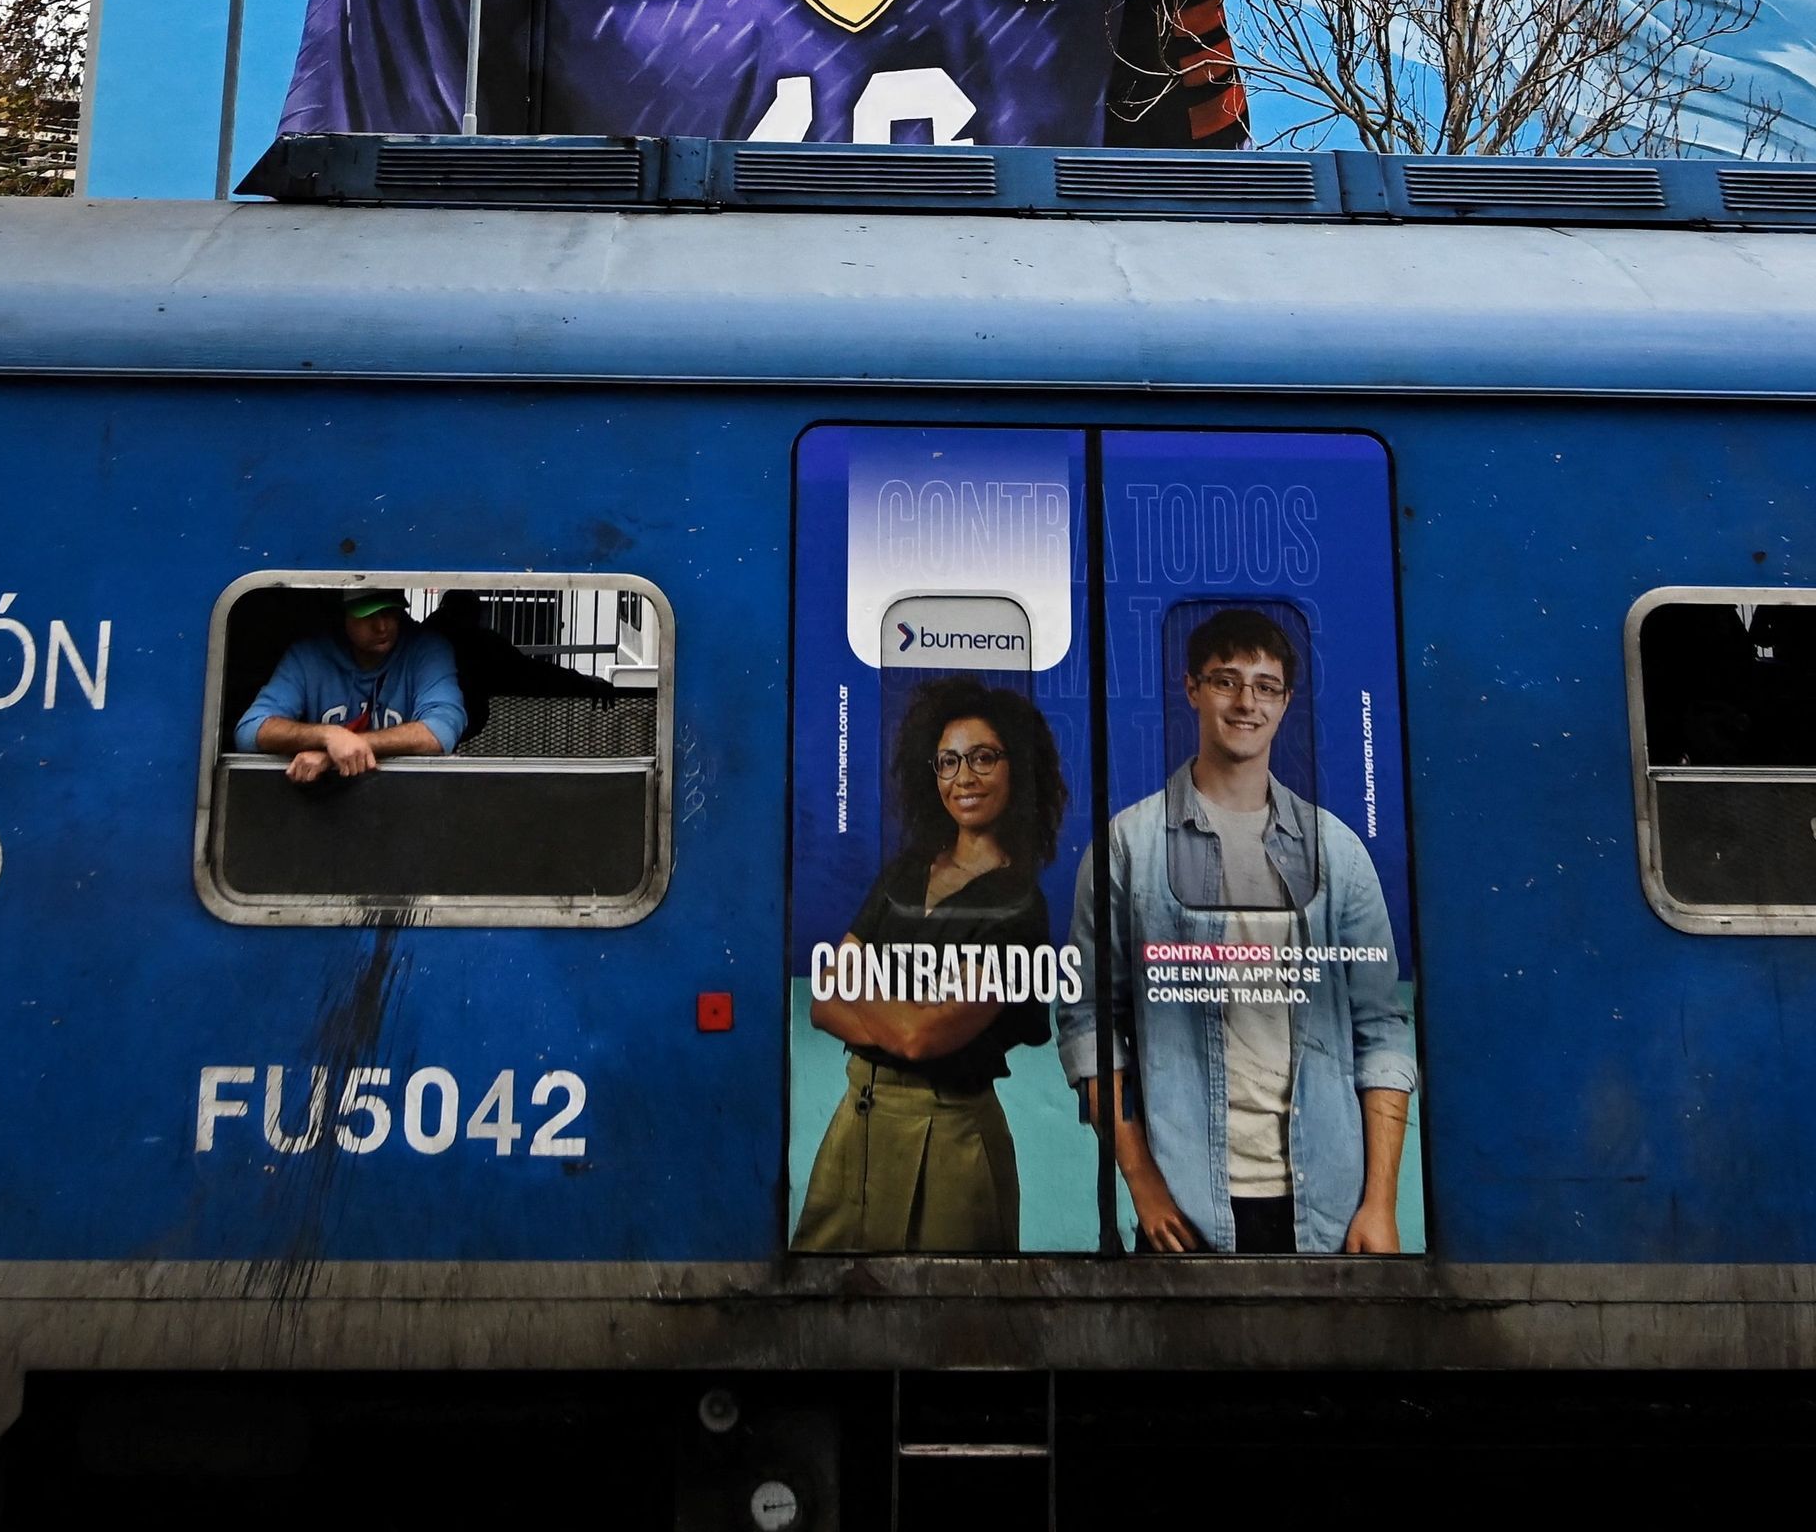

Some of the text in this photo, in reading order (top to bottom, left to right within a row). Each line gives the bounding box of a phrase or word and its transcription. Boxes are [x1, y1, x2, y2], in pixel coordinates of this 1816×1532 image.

[1127, 484, 1319, 586] TODOS
[920, 626, 1025, 652] bumeran
[836, 684, 849, 834] www.bumeran.com.ar
[1360, 689, 1378, 838] www.bumeran.com.ar
[809, 941, 1082, 1004] CONTRATADOS
[1145, 943, 1387, 966] CONTRA TODOS LOS QUE DICEN
[1146, 966, 1321, 984] QUE EN UNA APP NO SE
[1146, 987, 1310, 1004] CONSIGUE TRABAJO.
[194, 1065, 587, 1157] FU5042
